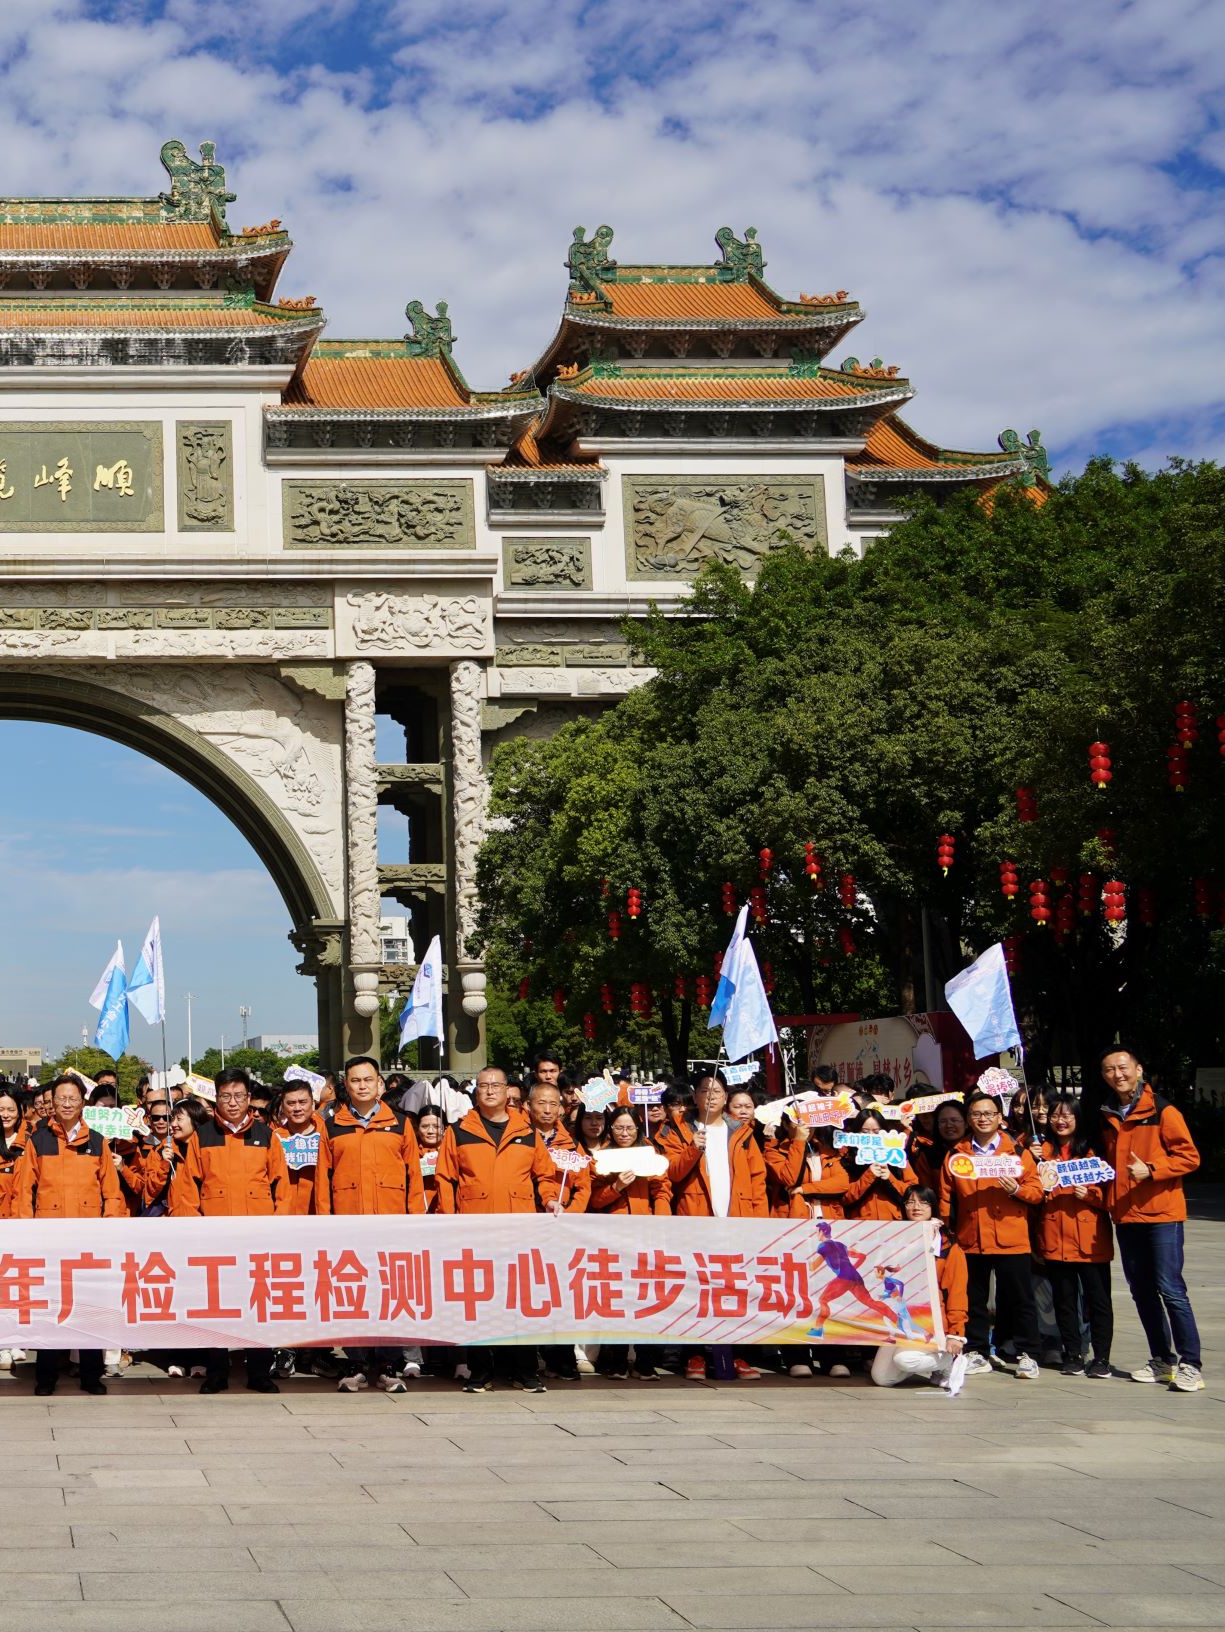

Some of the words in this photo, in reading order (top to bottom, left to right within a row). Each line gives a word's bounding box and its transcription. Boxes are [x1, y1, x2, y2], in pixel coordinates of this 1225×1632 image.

[84, 1108, 123, 1121] 越努力
[91, 1123, 131, 1138] 越幸运
[295, 1138, 318, 1149] 稳住
[836, 1132, 881, 1146] 我们都是
[980, 1168, 1016, 1176] 共创未来
[1057, 1159, 1100, 1173] 颜值越高
[1061, 1170, 1106, 1185] 责任越大
